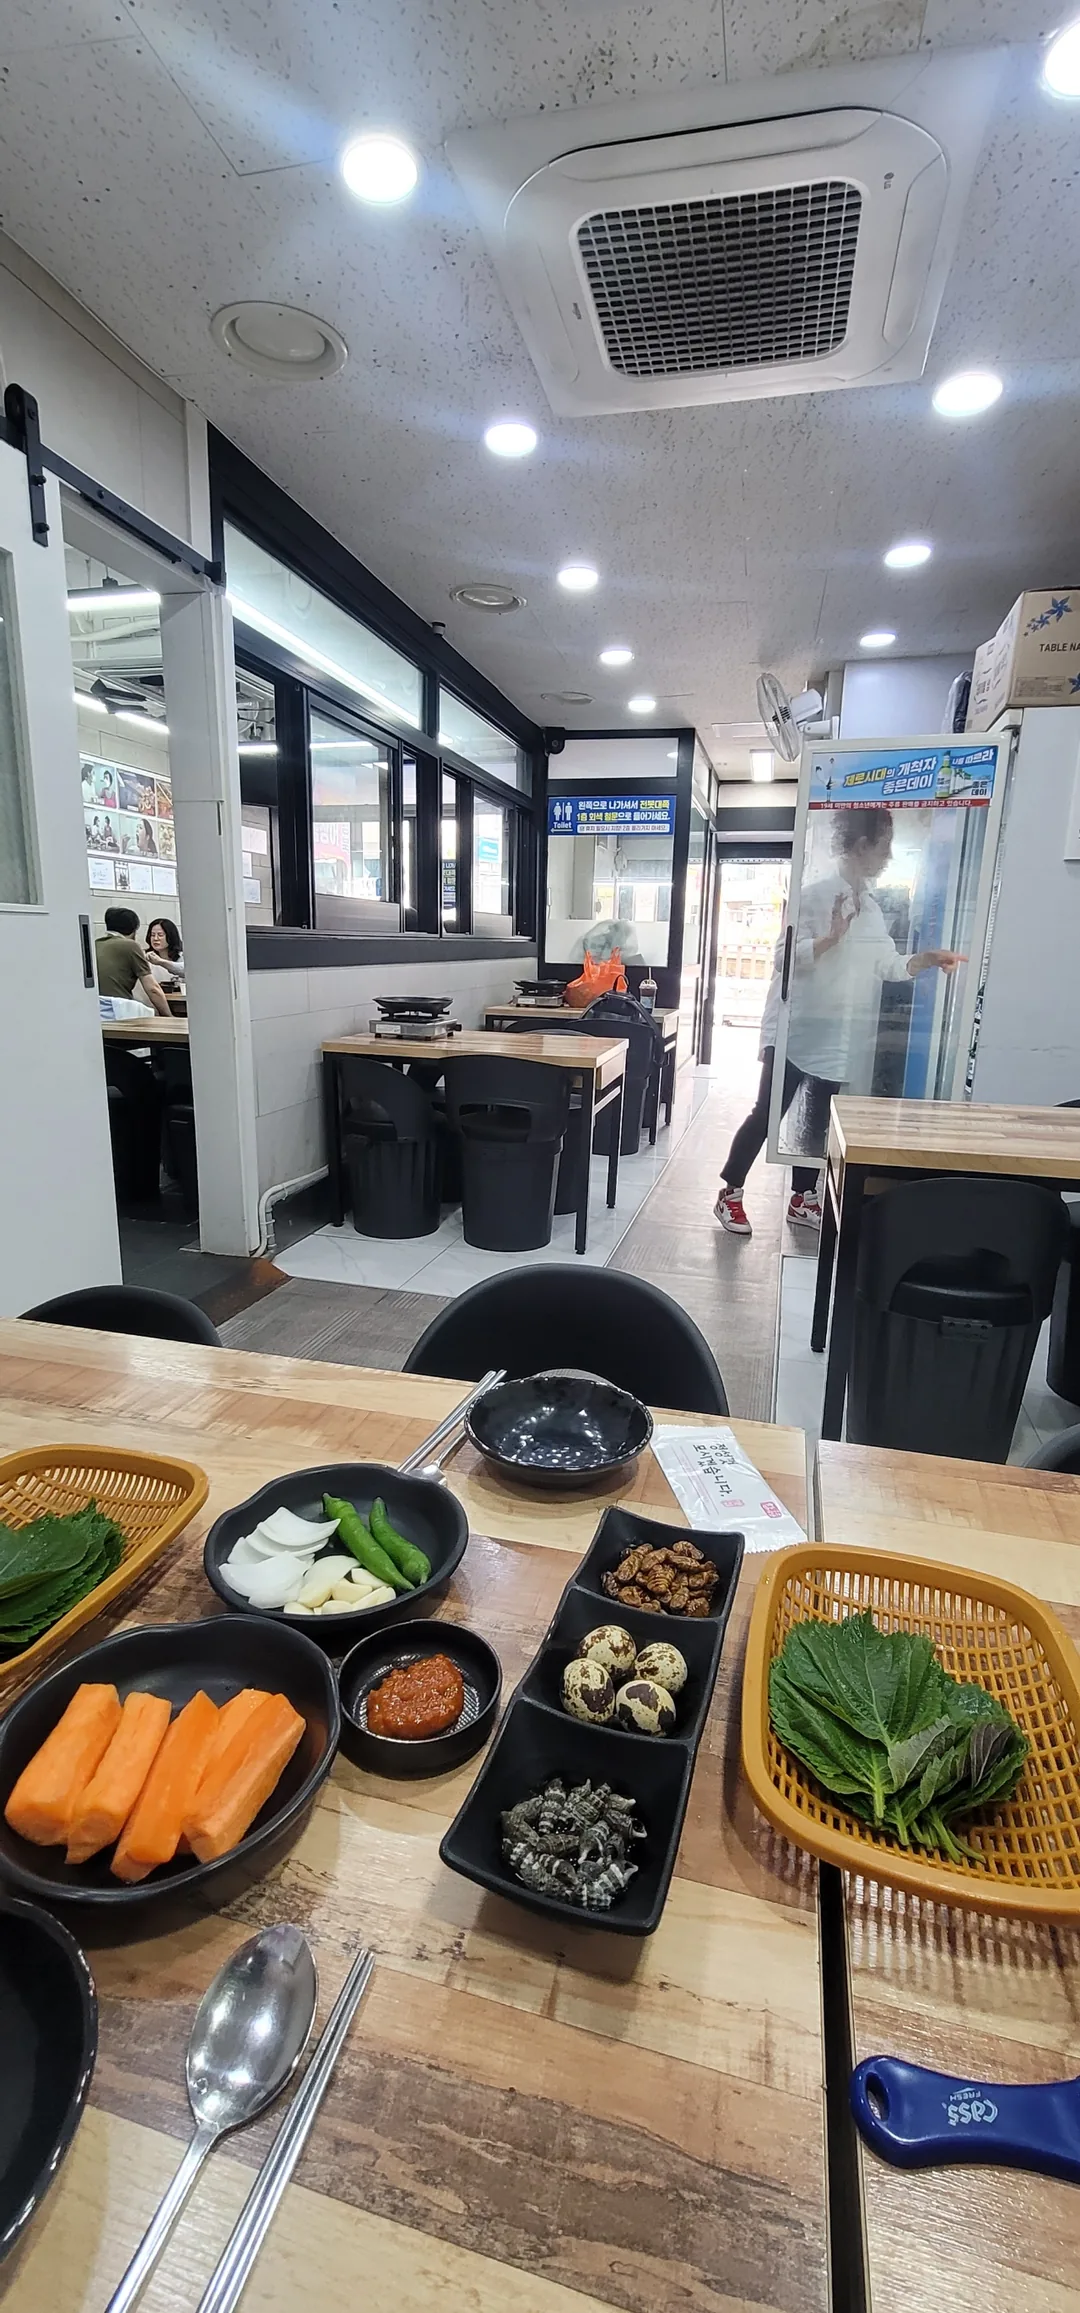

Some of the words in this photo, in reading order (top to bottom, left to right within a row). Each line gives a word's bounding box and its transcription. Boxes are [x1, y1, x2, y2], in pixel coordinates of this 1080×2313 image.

[1039, 643, 1068, 652] TABLE
[965, 749, 994, 764] 따르라
[844, 768, 896, 787] 제로시대의
[897, 756, 937, 777] 개척자
[882, 774, 934, 795] 좋은데이
[578, 800, 607, 810] 왼쪽으로
[608, 800, 639, 810] 나가셔서
[553, 821, 572, 829] Toilet
[710, 1443, 737, 1465] 정성껏
[693, 1444, 733, 1497] 모시겠습니다.
[950, 2090, 981, 2101] FRESH
